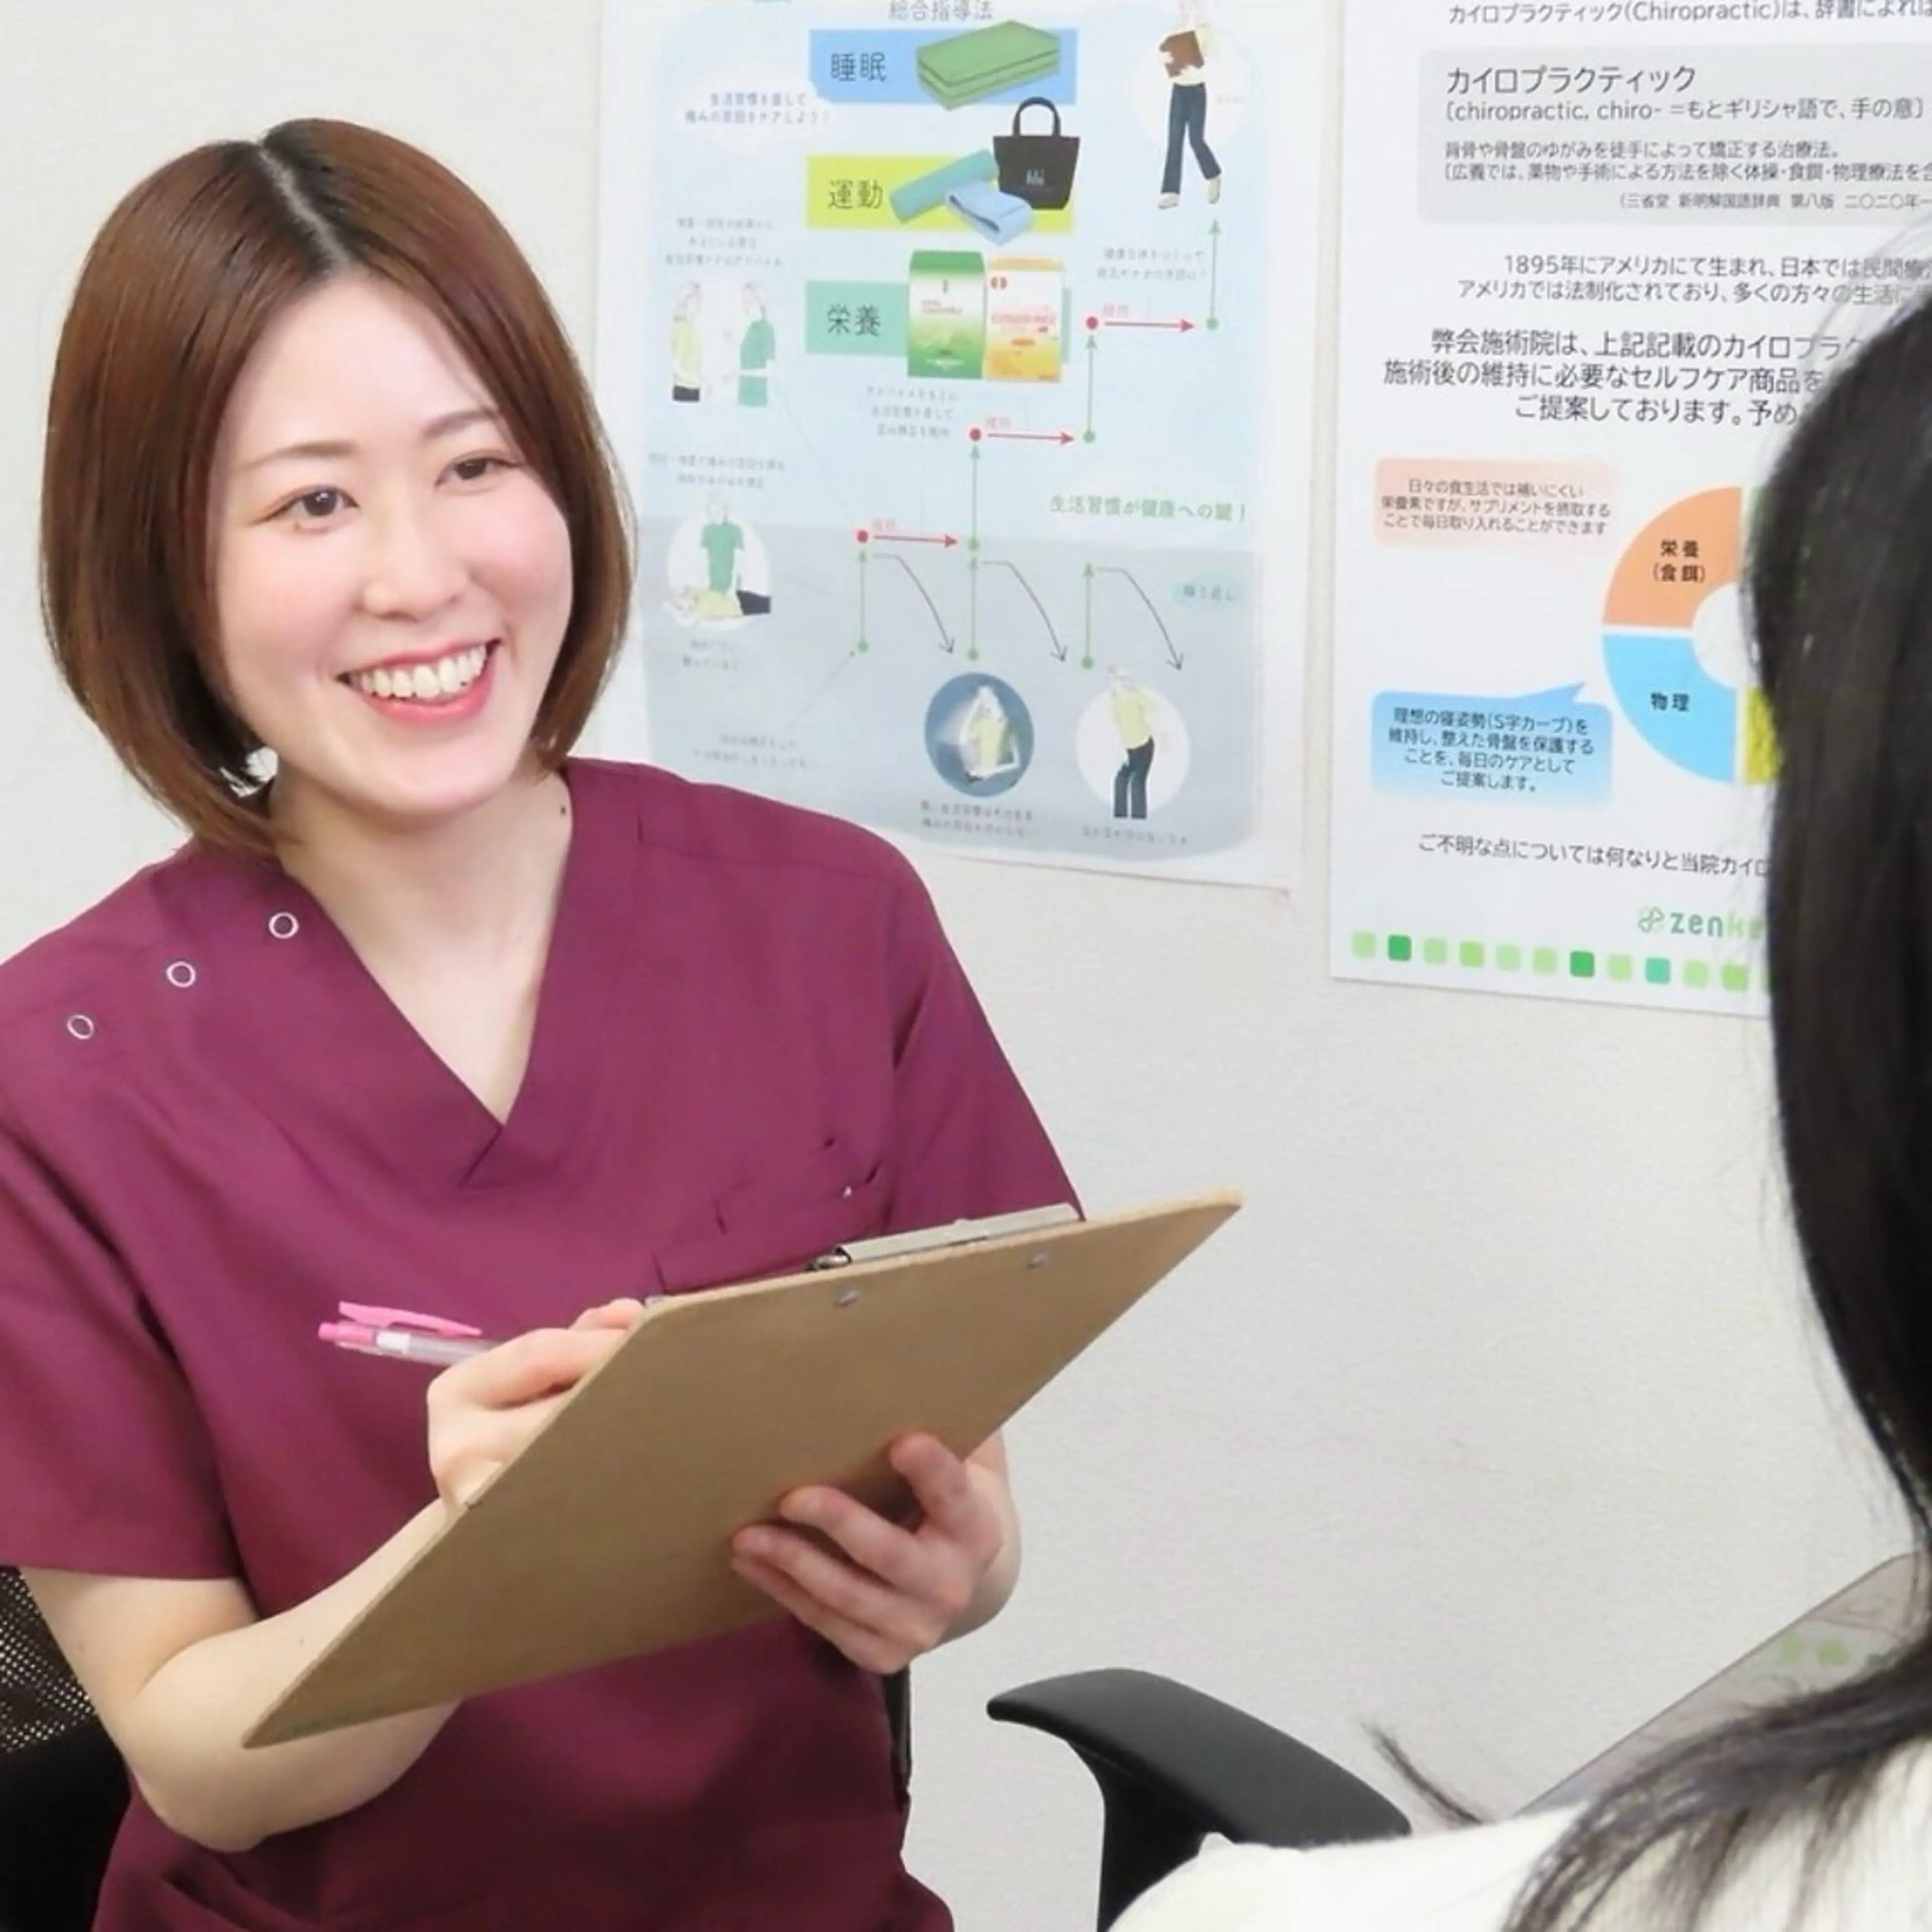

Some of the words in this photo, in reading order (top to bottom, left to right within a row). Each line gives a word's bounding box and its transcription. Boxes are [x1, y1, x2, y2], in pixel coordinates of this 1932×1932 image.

[889, 0, 993, 22] 総合指導法
[830, 52, 887, 83] 睡眠
[1447, 65, 1696, 95] カイロプラクティック
[1597, 100, 1661, 120] chiro-
[827, 179, 883, 210] 運動
[827, 304, 881, 337] 栄養
[1384, 359, 1826, 394] 施術後の維持に必要なセルフケア商品を
[1515, 394, 1798, 426] ご提案しております。予め
[1409, 479, 1584, 498] 日々の食生活では補いにくい
[1382, 496, 1611, 517] 栄養素ですが、サプリメントを摂取する
[1384, 514, 1608, 535] ことで毎日取り入れることができます
[1661, 539, 1699, 558] 栄養
[1651, 692, 1689, 711] 物理
[1389, 728, 1594, 754] 維持し、整えた骨盤を保護する
[1404, 749, 1575, 774] ことを、毎日のケアとして
[1441, 771, 1537, 792] ご提案します。
